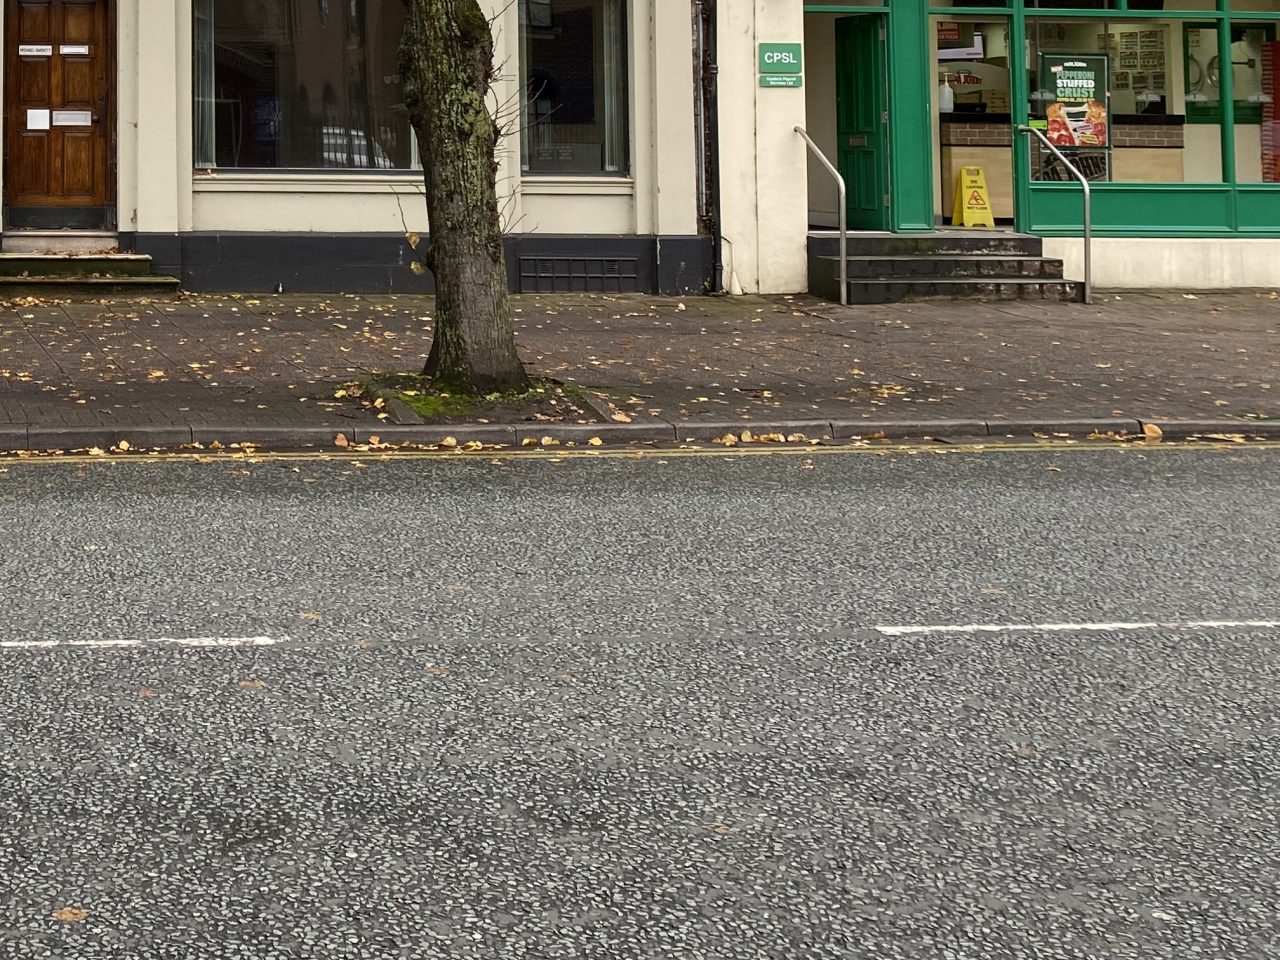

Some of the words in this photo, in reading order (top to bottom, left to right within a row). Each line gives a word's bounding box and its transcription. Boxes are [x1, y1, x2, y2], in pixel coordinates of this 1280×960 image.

[764, 52, 798, 63] CPSL
[1056, 71, 1095, 80] PEPPERONI
[1056, 80, 1095, 88] STUFFED
[1056, 88, 1095, 98] CRUST
